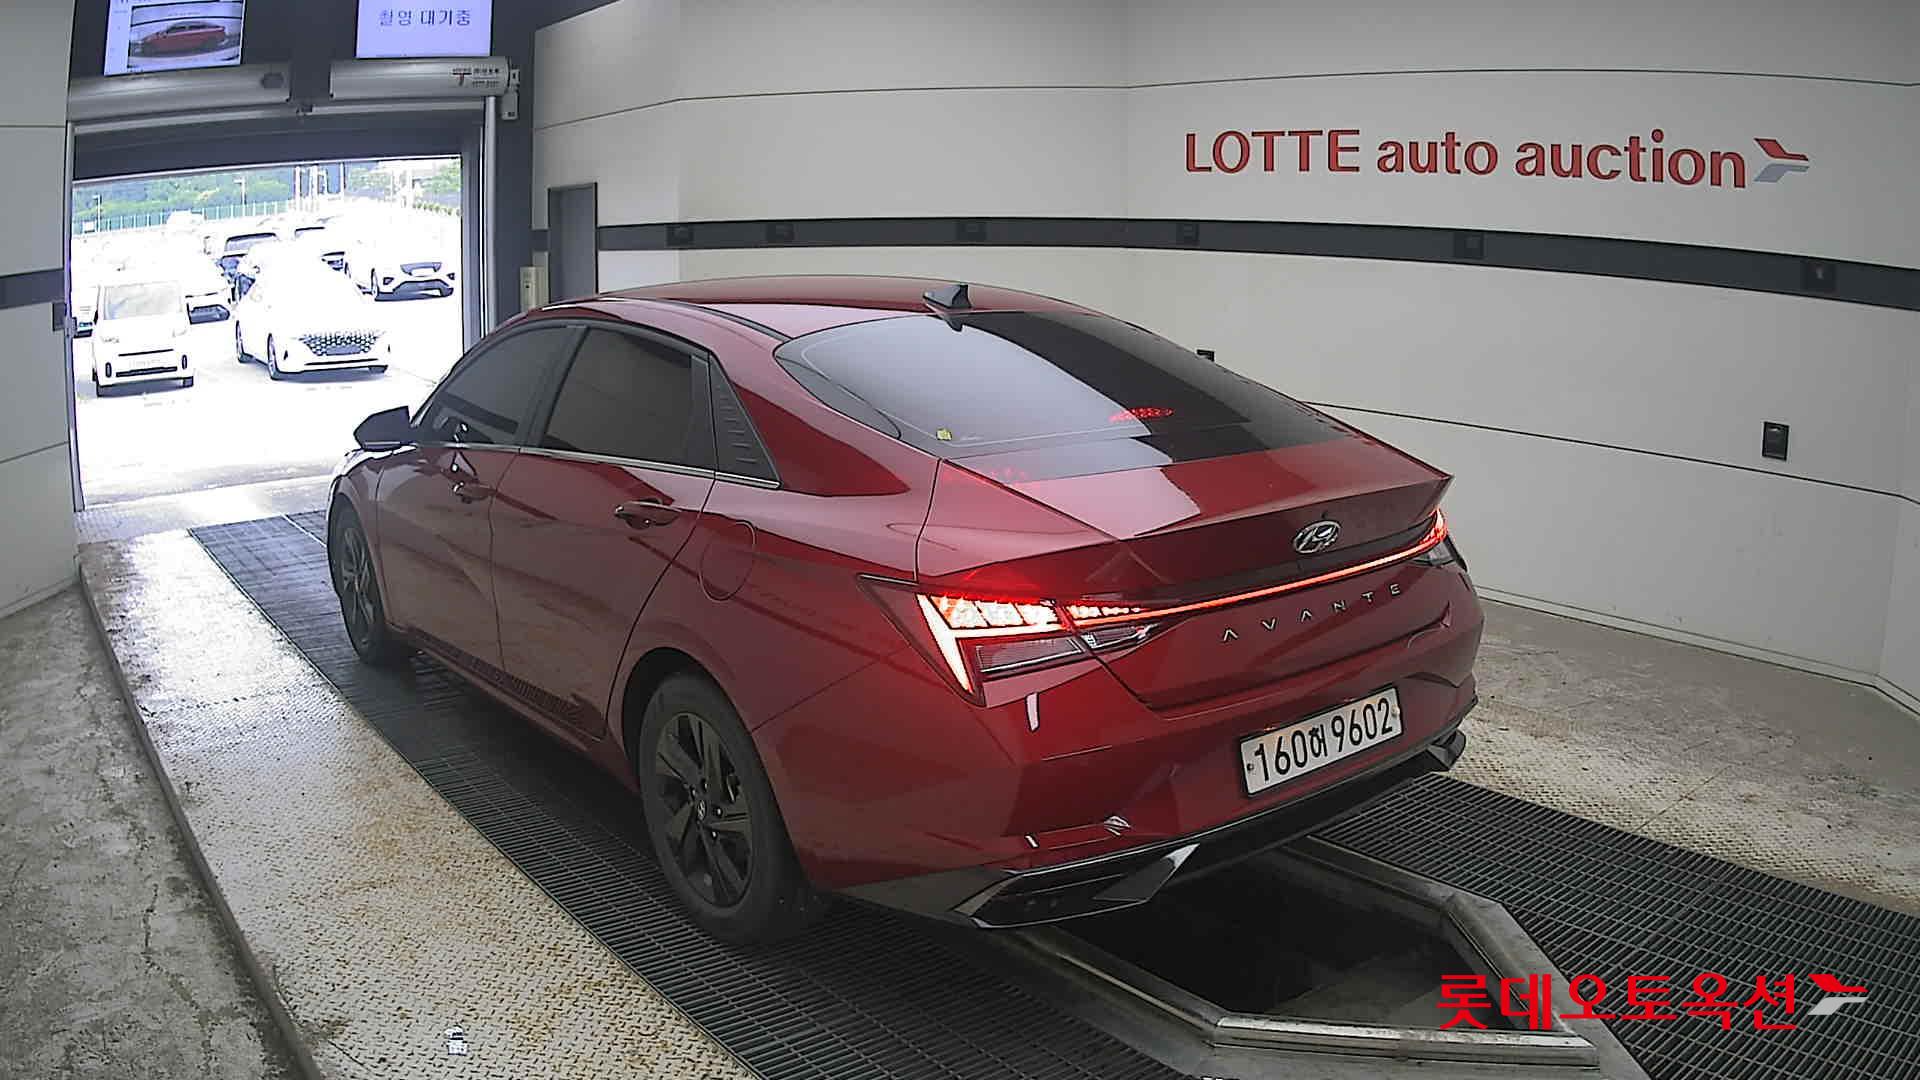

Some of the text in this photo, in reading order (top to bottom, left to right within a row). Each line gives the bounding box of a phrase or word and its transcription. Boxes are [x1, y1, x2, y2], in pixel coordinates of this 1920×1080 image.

[420, 9, 471, 26] 대기중
[1185, 129, 1746, 189] LOTTE auto auction
[1222, 583, 1401, 642] AVANTE
